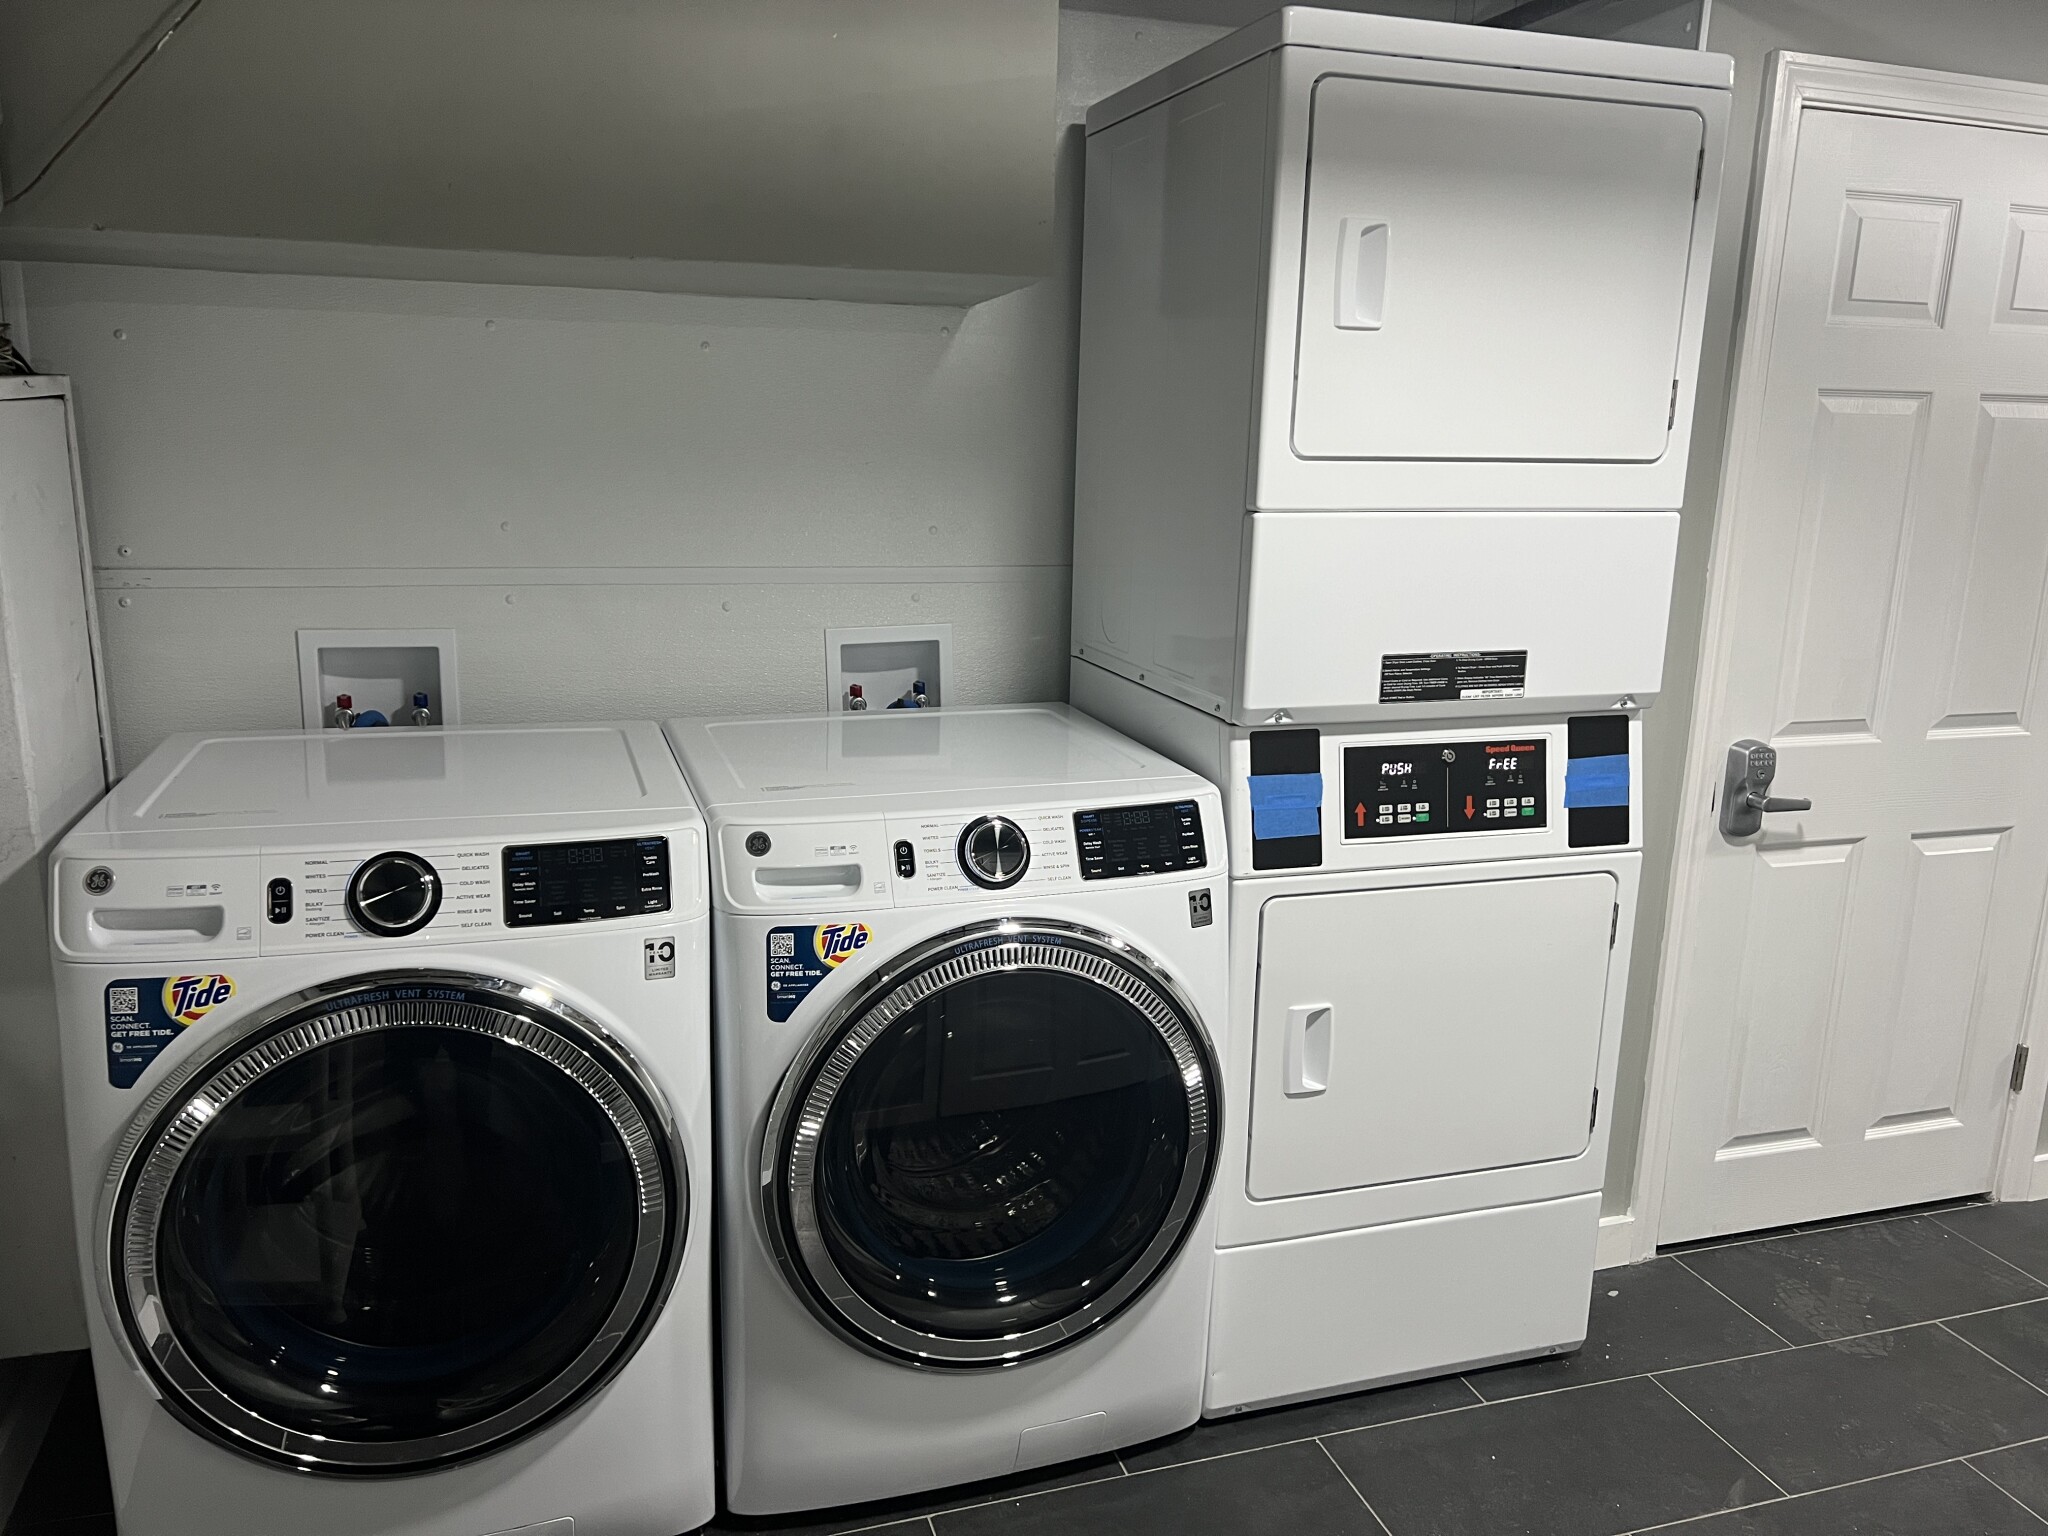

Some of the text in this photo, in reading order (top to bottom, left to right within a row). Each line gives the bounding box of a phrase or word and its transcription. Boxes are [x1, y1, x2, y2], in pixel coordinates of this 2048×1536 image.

[1486, 746, 1510, 754] Speed
[1382, 762, 1412, 776] PUSH
[1190, 893, 1211, 913] 10
[645, 942, 674, 963] 10
[822, 926, 868, 960] Tide
[954, 935, 1062, 955] ULTRAFRESH VENT SYSTEM
[172, 978, 232, 1018] Tide
[326, 989, 466, 1011] ULTRAFRESH VENT SYSTEM
